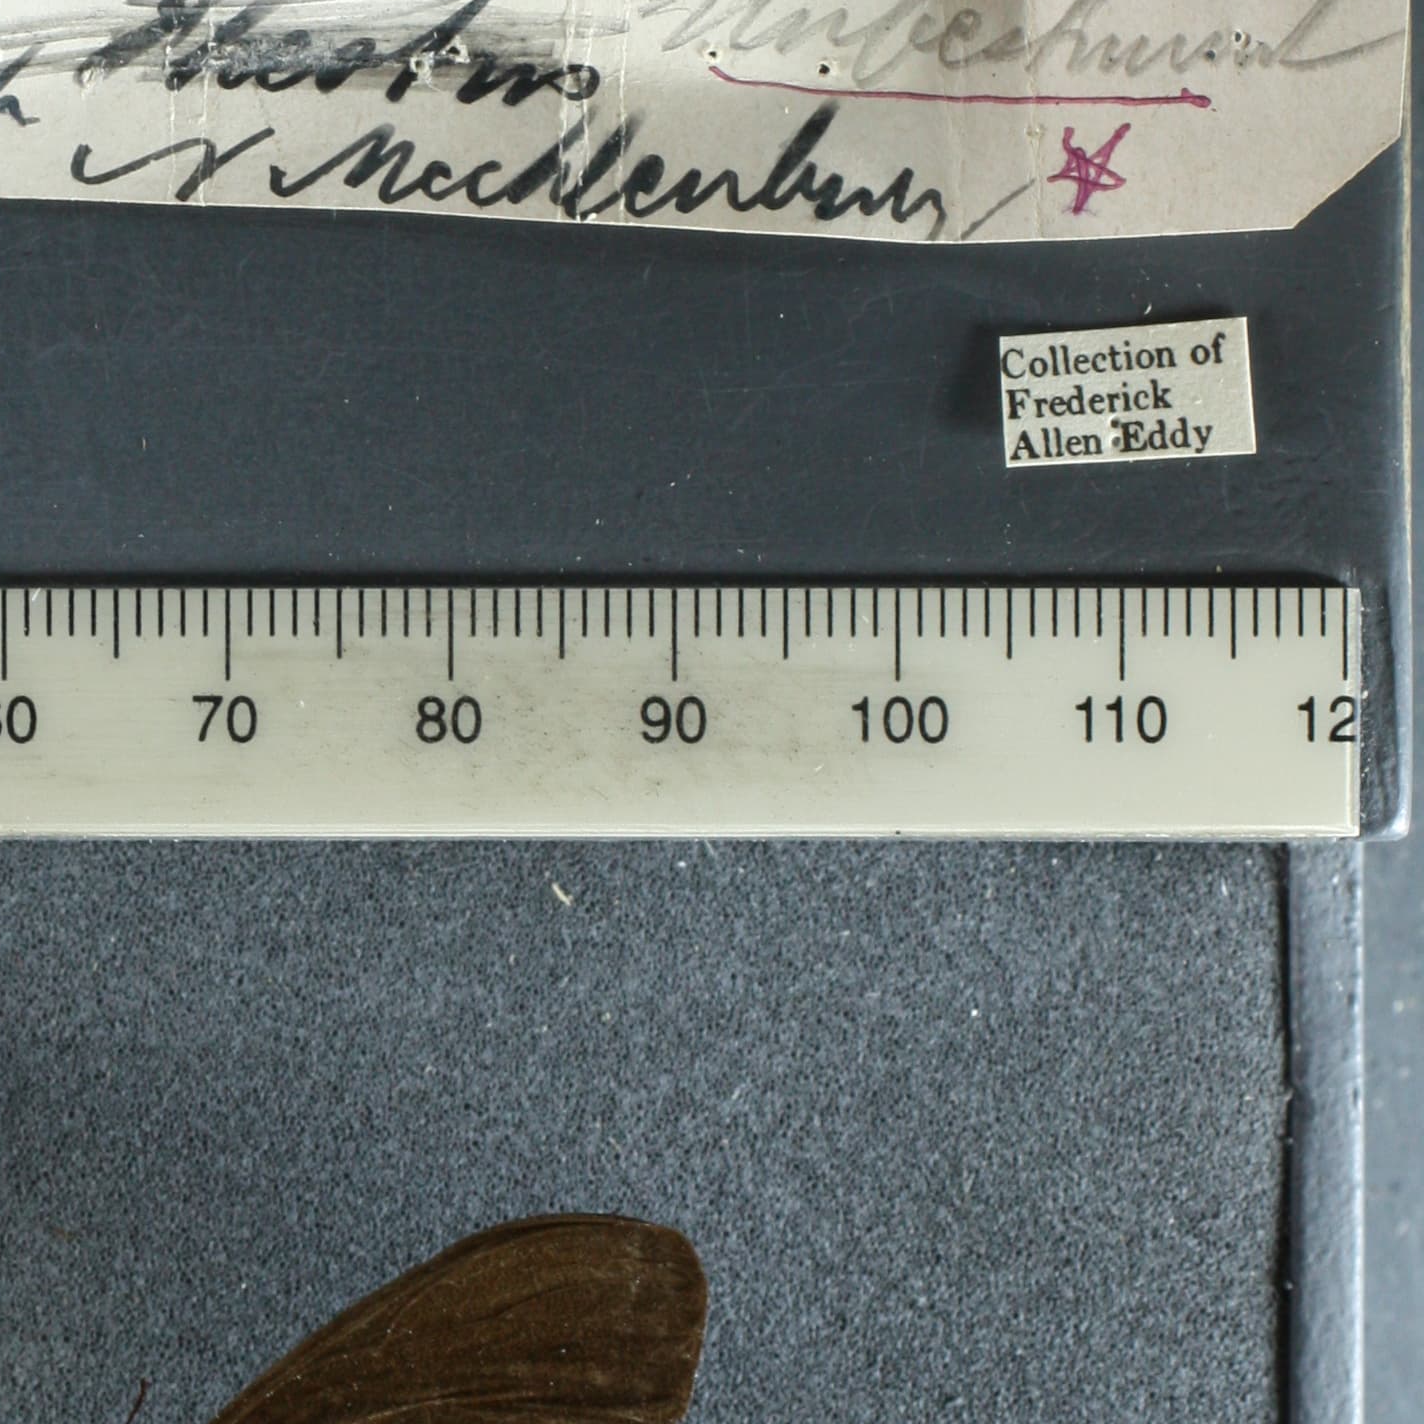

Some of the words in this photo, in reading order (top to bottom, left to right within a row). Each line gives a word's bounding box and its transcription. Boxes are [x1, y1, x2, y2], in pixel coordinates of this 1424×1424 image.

[999, 340, 1177, 381] Collection
[1190, 331, 1226, 366] of
[1005, 378, 1173, 421] Frederick
[1009, 427, 1103, 461] Allen
[1119, 417, 1217, 459] Eddy
[192, 694, 258, 744] 70
[415, 695, 482, 744] 80
[640, 695, 707, 744] 90
[851, 695, 949, 744] 100
[1075, 695, 1167, 744] 110
